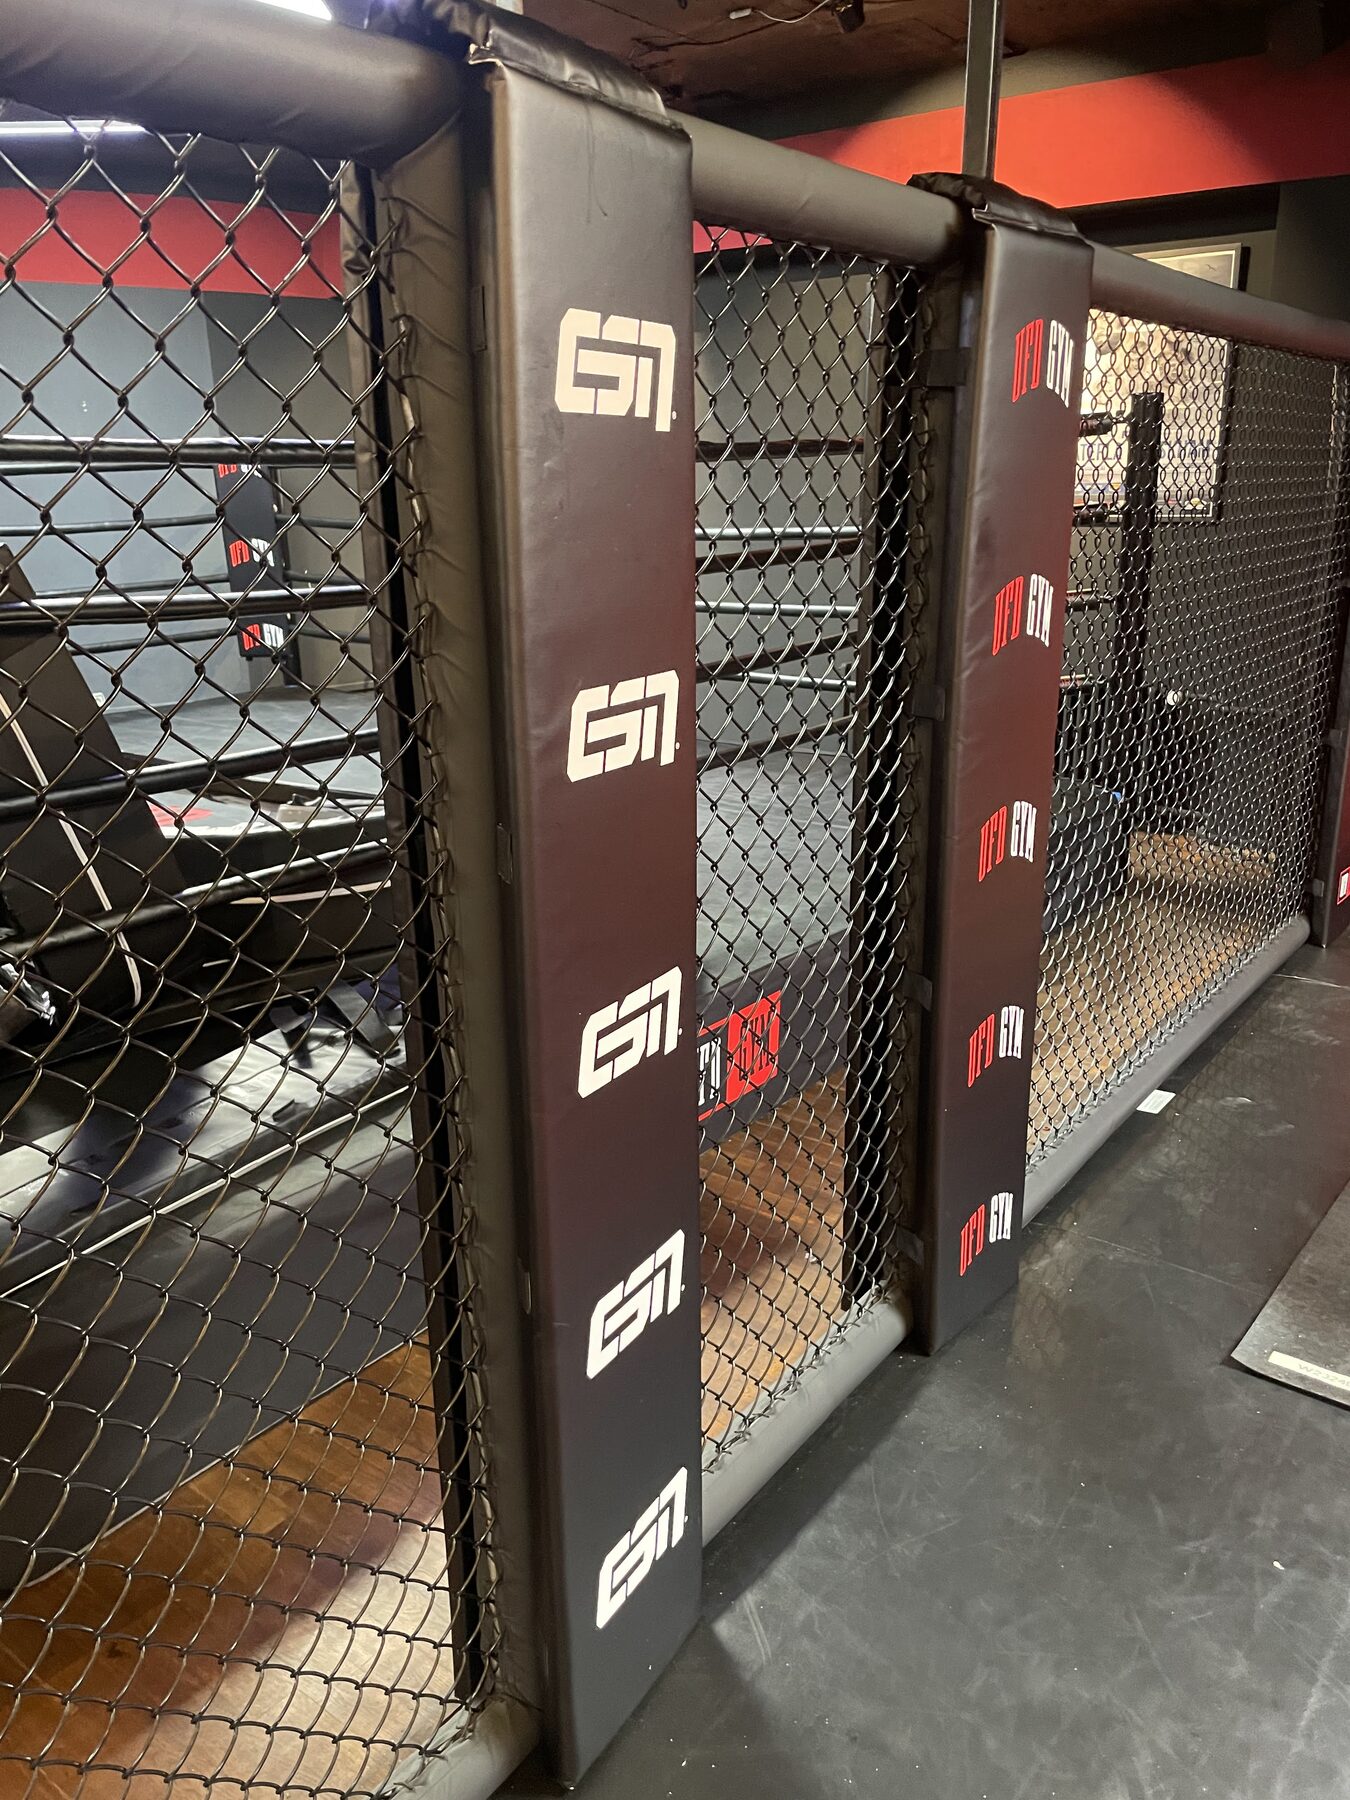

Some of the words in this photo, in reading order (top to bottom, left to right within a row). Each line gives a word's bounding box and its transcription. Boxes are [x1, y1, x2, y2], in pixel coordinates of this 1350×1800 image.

[1045, 319, 1075, 409] GYM
[1026, 573, 1054, 648] GYM
[1010, 800, 1037, 864] GYM
[998, 1005, 1025, 1060] GYM
[989, 1192, 1014, 1243] GYM
